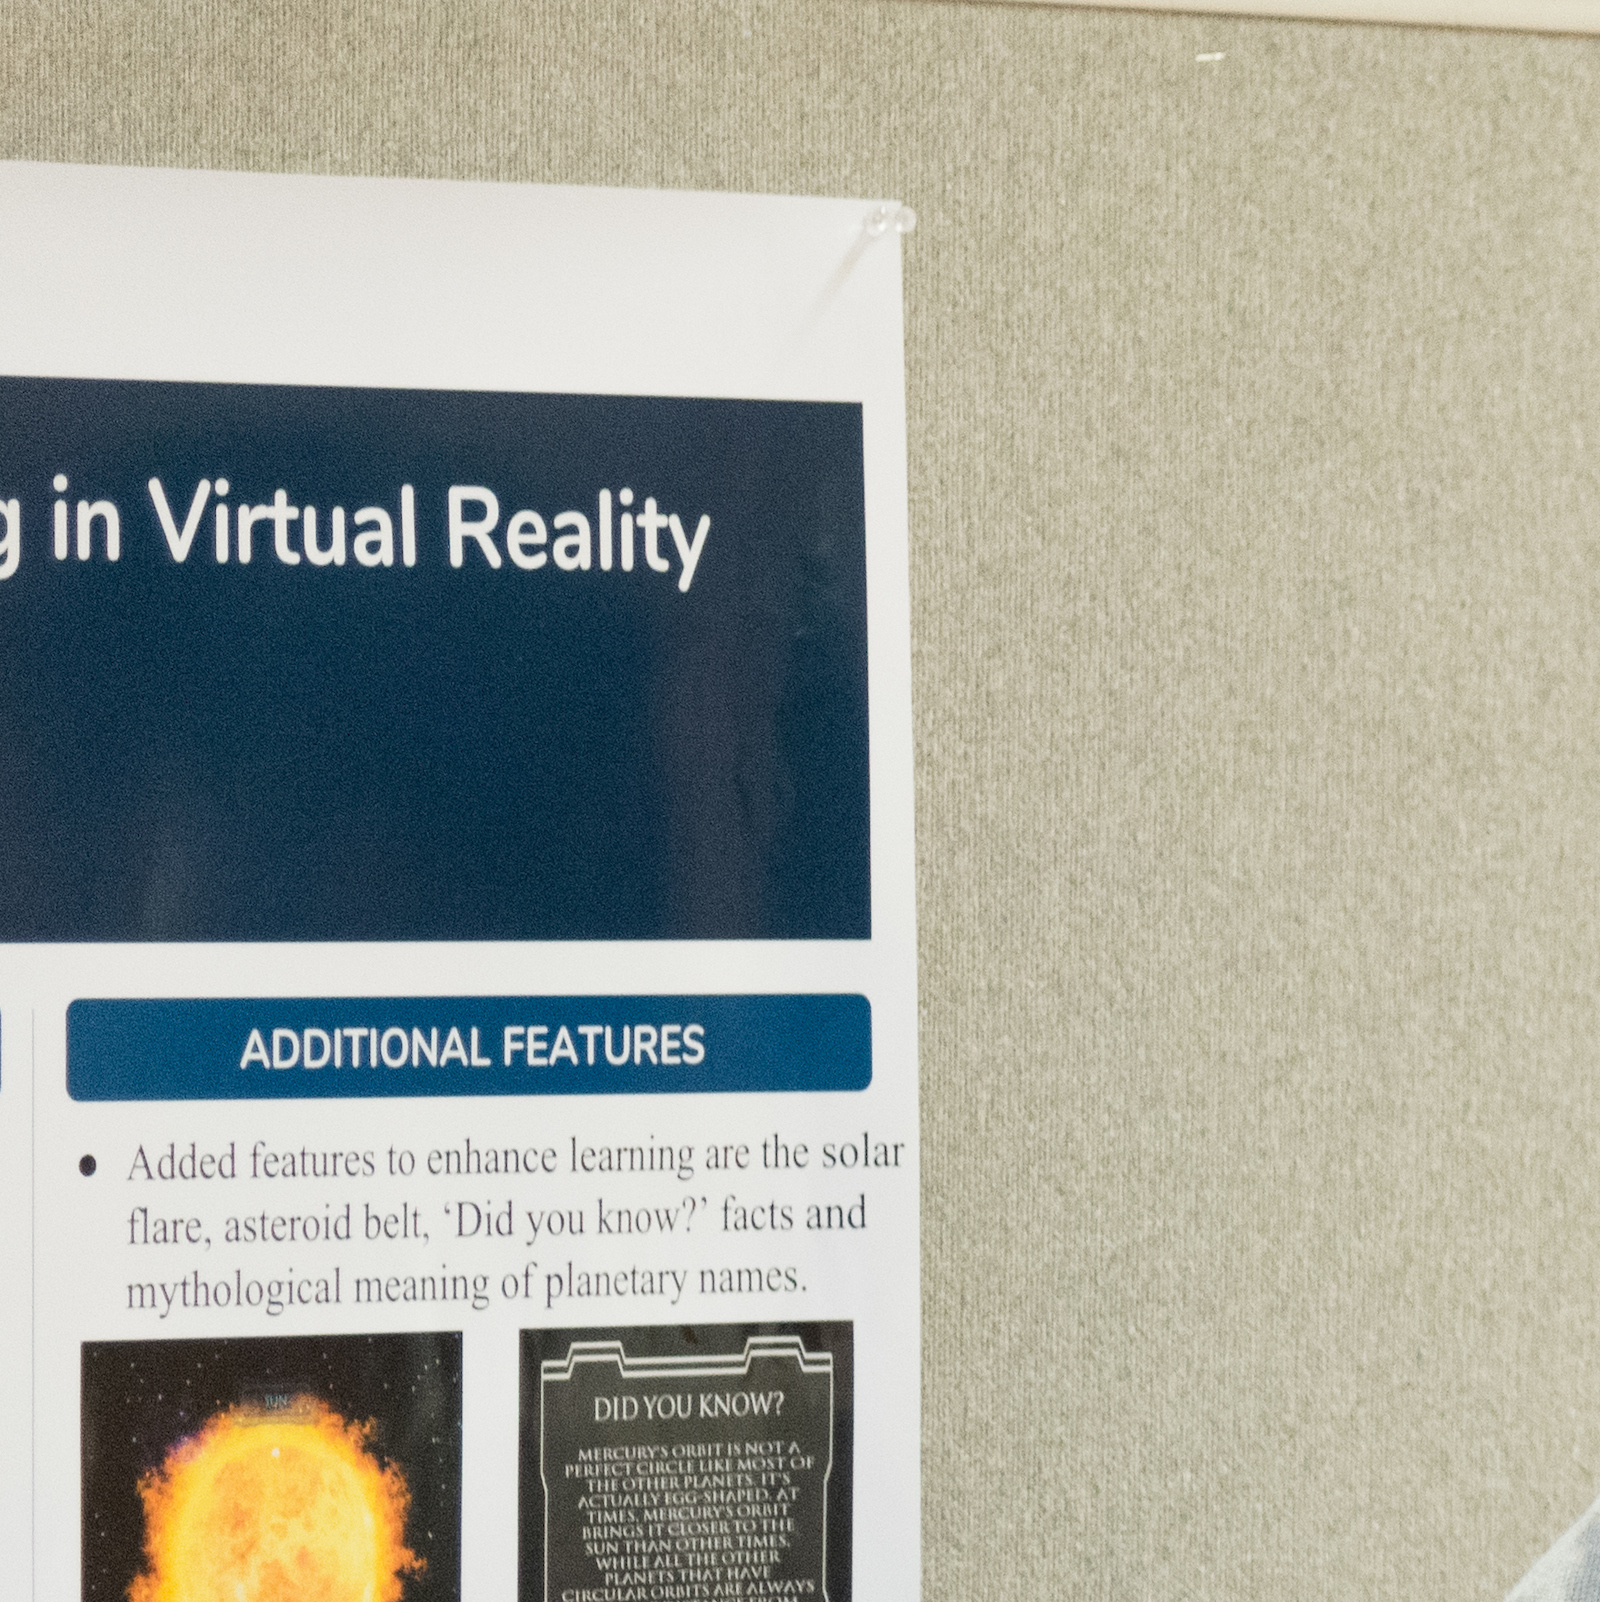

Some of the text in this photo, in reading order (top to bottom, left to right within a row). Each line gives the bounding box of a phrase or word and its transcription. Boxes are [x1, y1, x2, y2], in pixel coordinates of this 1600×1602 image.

[52, 472, 121, 562] in
[147, 476, 417, 569] Virtual
[447, 484, 711, 594] Reality
[239, 1023, 706, 1070] ADDITIONAL FEATURES
[127, 1131, 905, 1183] Added features to enhance learning are the solar
[128, 1206, 212, 1246] flare,
[224, 1202, 352, 1244] asteroid
[364, 1201, 430, 1241] belt,
[525, 1210, 585, 1248] you
[722, 1194, 794, 1233] facts
[805, 1192, 867, 1231] and
[127, 1260, 807, 1320] mythological meaning of planetary names.
[594, 1390, 785, 1422] DID YOU KNOW?
